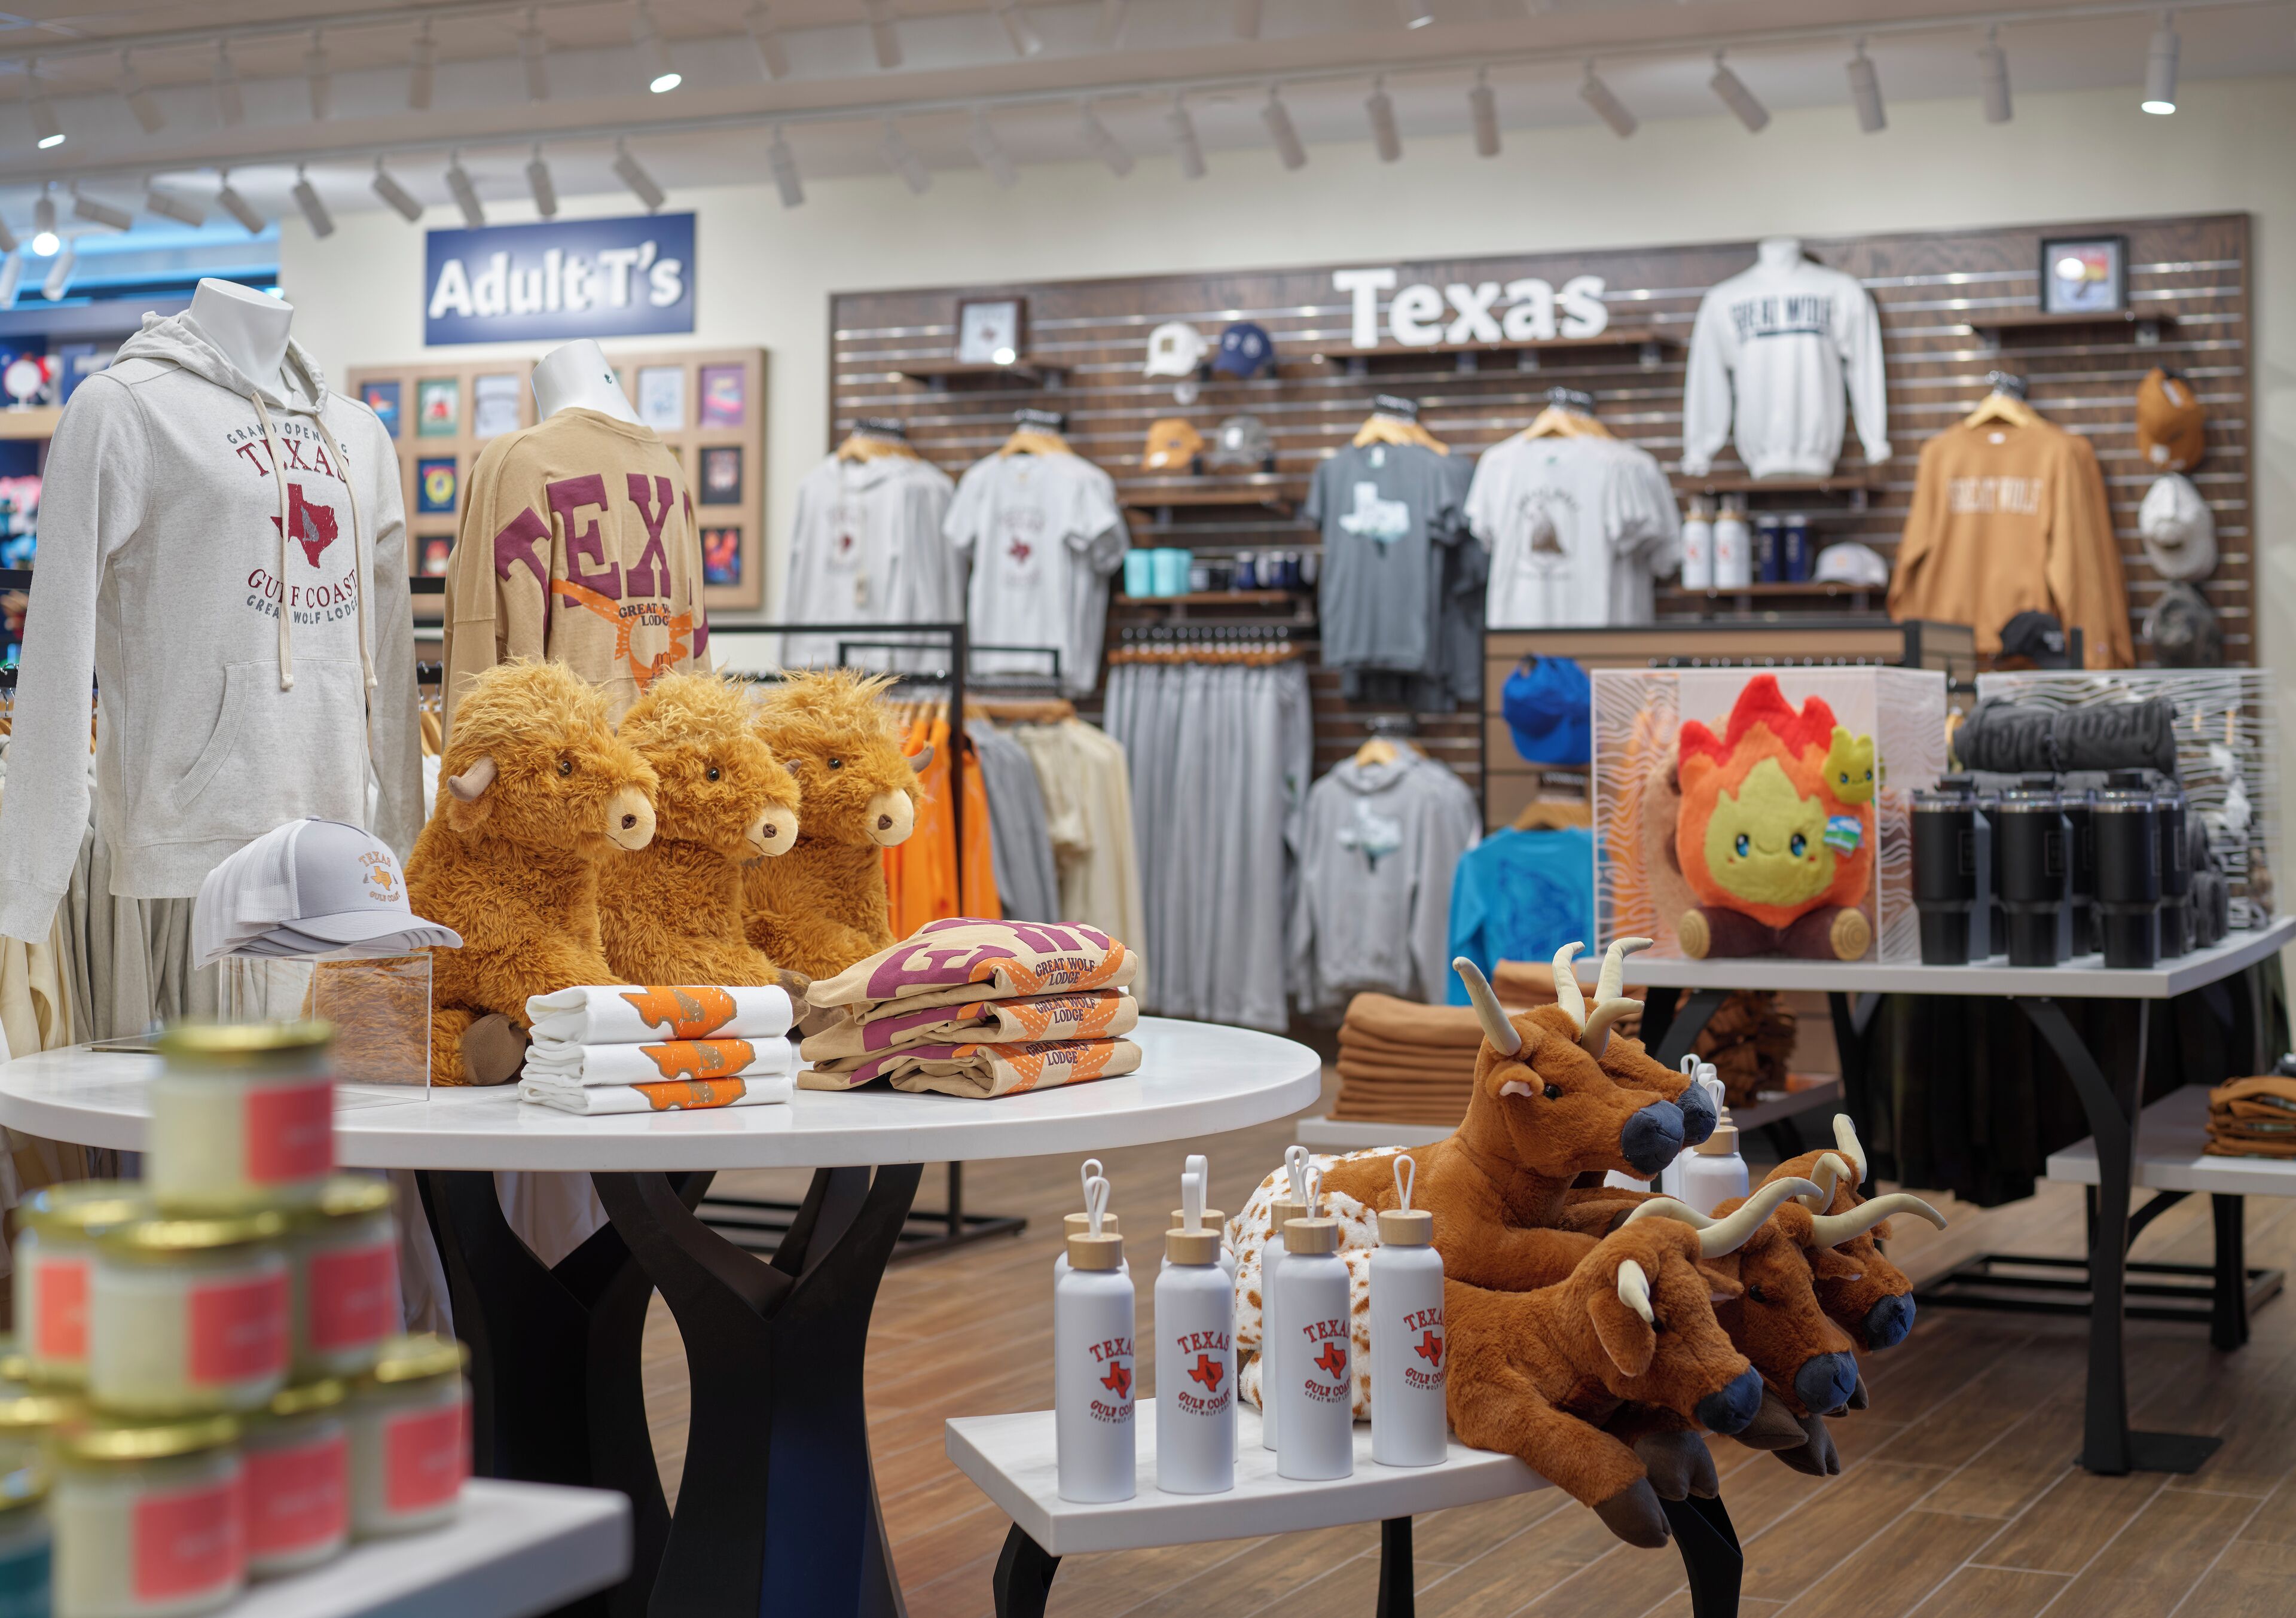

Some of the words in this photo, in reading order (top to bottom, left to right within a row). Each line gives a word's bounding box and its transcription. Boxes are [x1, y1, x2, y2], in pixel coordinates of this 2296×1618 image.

[428, 248, 588, 319] Adult
[599, 240, 683, 308] T's
[1331, 267, 1609, 349] Texas
[284, 422, 347, 453] OPENG
[306, 569, 359, 609] COAST
[246, 594, 280, 619] GREA
[294, 610, 320, 624] WOLF
[326, 596, 358, 622] LODGE
[619, 603, 658, 618] GREAT
[640, 615, 668, 626] LODG
[358, 851, 391, 867] TEXAS
[369, 890, 386, 902] GULF
[1035, 957, 1065, 977] GREAT
[1066, 957, 1095, 973] WOLF
[1048, 971, 1080, 986] LODGE
[1034, 997, 1065, 1014] GREAT
[1065, 996, 1096, 1009] WOLF
[1053, 1008, 1084, 1024] LODGE
[1025, 1042, 1058, 1057] GREAT
[1058, 1042, 1089, 1052] WOLF
[1045, 1051, 1078, 1066] LODGE
[1089, 1338, 1134, 1363] TEXA
[1177, 1330, 1231, 1355] TEXAS
[1405, 1367, 1430, 1385] GULF
[1305, 1379, 1331, 1397] GULF
[1178, 1391, 1205, 1410] GULF
[1207, 1387, 1231, 1409] COAST
[1090, 1400, 1116, 1418] GULF
